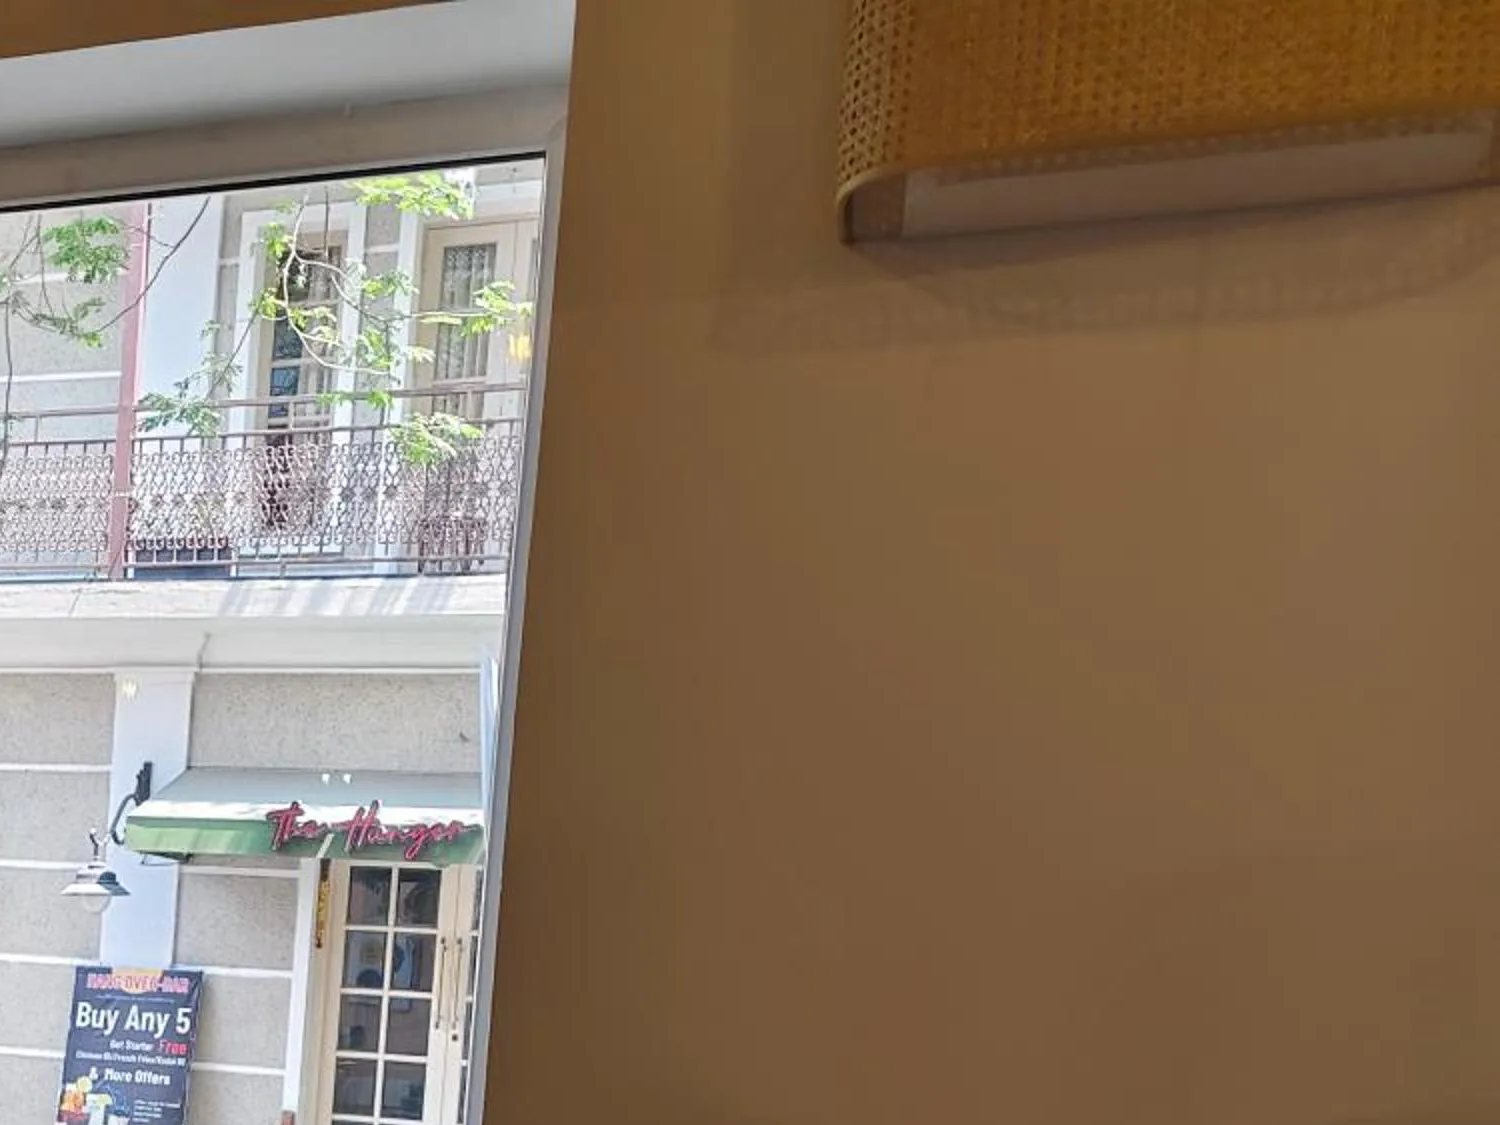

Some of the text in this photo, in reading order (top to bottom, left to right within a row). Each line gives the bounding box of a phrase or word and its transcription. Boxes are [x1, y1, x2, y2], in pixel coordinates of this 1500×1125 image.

[266, 800, 329, 851] The
[75, 1001, 192, 1039] Buy Any 5
[158, 1039, 188, 1055] Free
[104, 1067, 133, 1082] More
[134, 1069, 171, 1085] Offers
